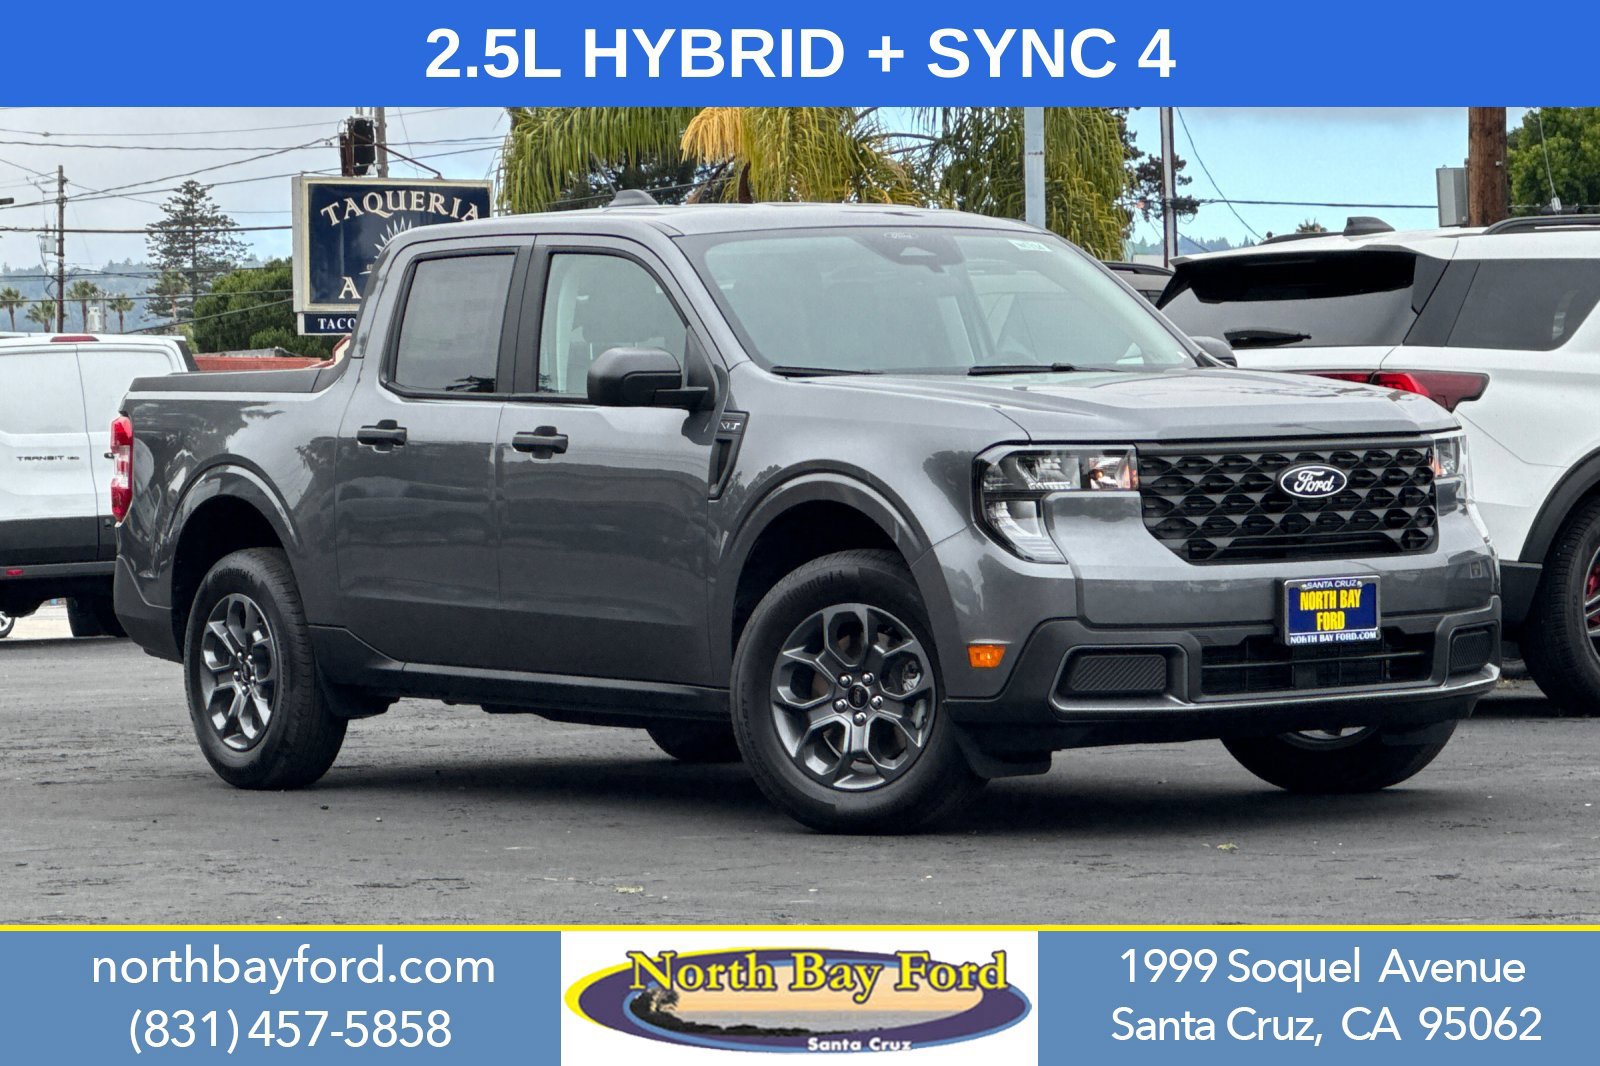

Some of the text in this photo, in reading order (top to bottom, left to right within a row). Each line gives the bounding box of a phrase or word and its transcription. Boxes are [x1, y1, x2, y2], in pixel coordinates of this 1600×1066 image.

[320, 190, 479, 227] TAQUERIA
[1293, 470, 1335, 493] Ford
[1306, 579, 1357, 590] SANTA CRUZ
[1300, 588, 1361, 611] NORTH BAY
[1316, 610, 1345, 631] FORD
[1290, 631, 1377, 644] NORTH BAY FORD.COM
